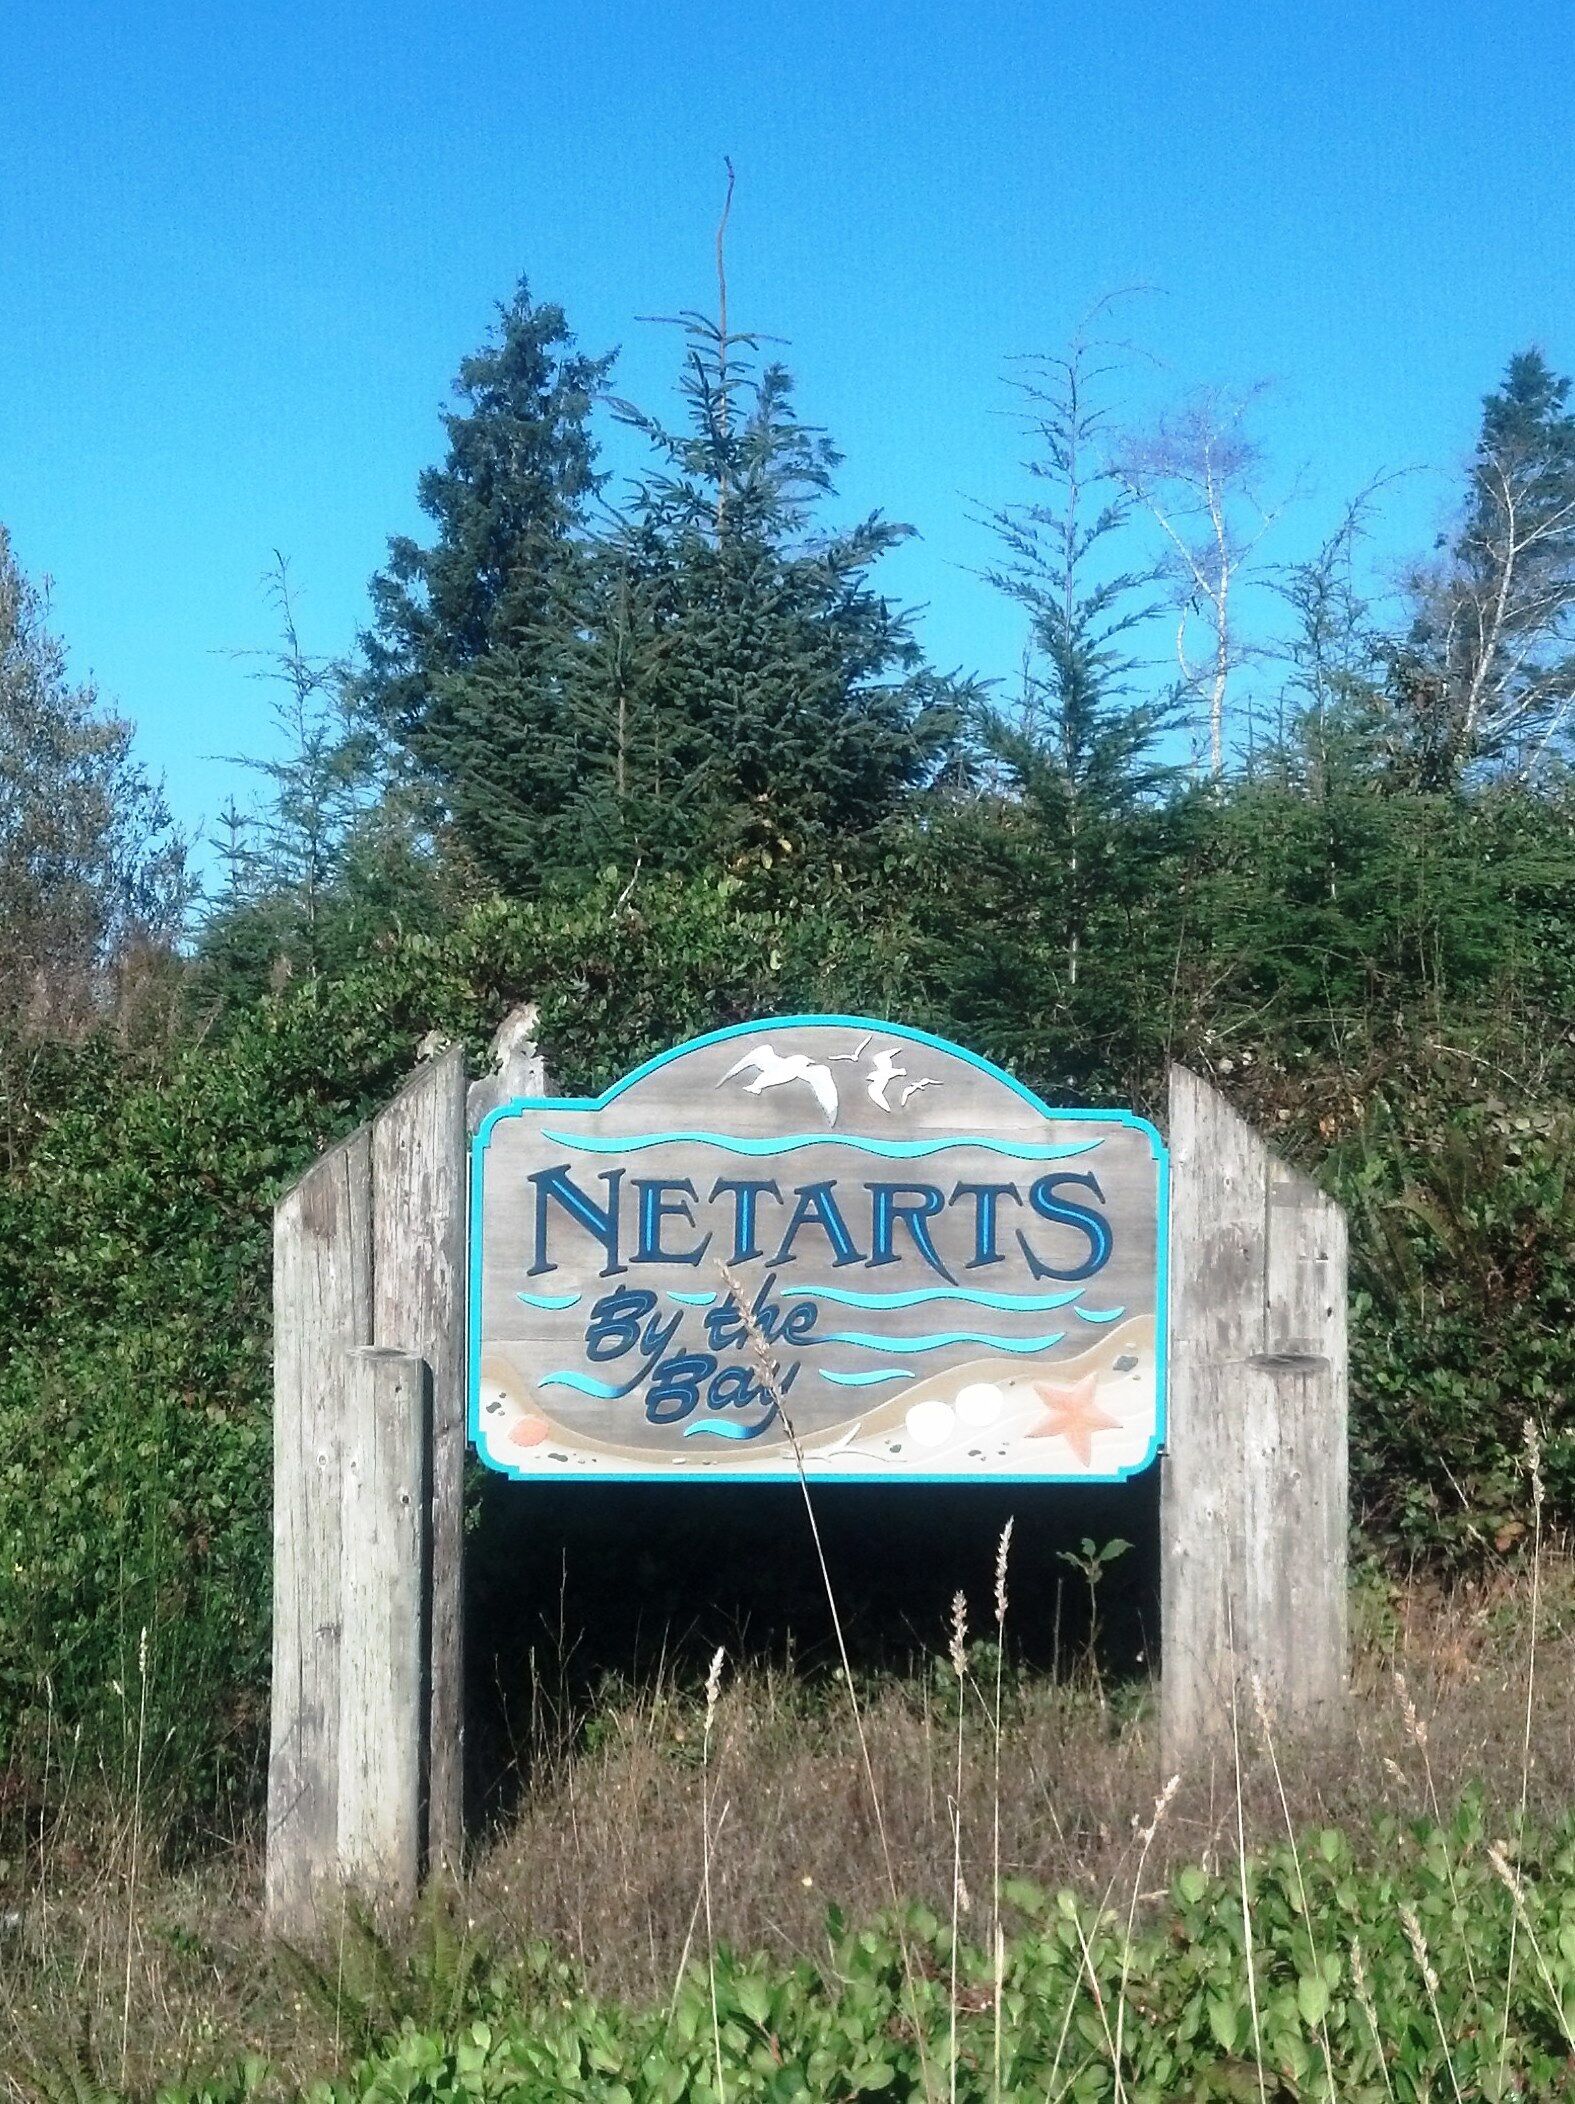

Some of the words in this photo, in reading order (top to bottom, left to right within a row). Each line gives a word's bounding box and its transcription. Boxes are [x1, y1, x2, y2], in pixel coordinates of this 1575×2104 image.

[526, 1162, 1115, 1287] NETARTS
[584, 1283, 685, 1398] By
[702, 1272, 820, 1352] the
[644, 1347, 802, 1439] Bay
